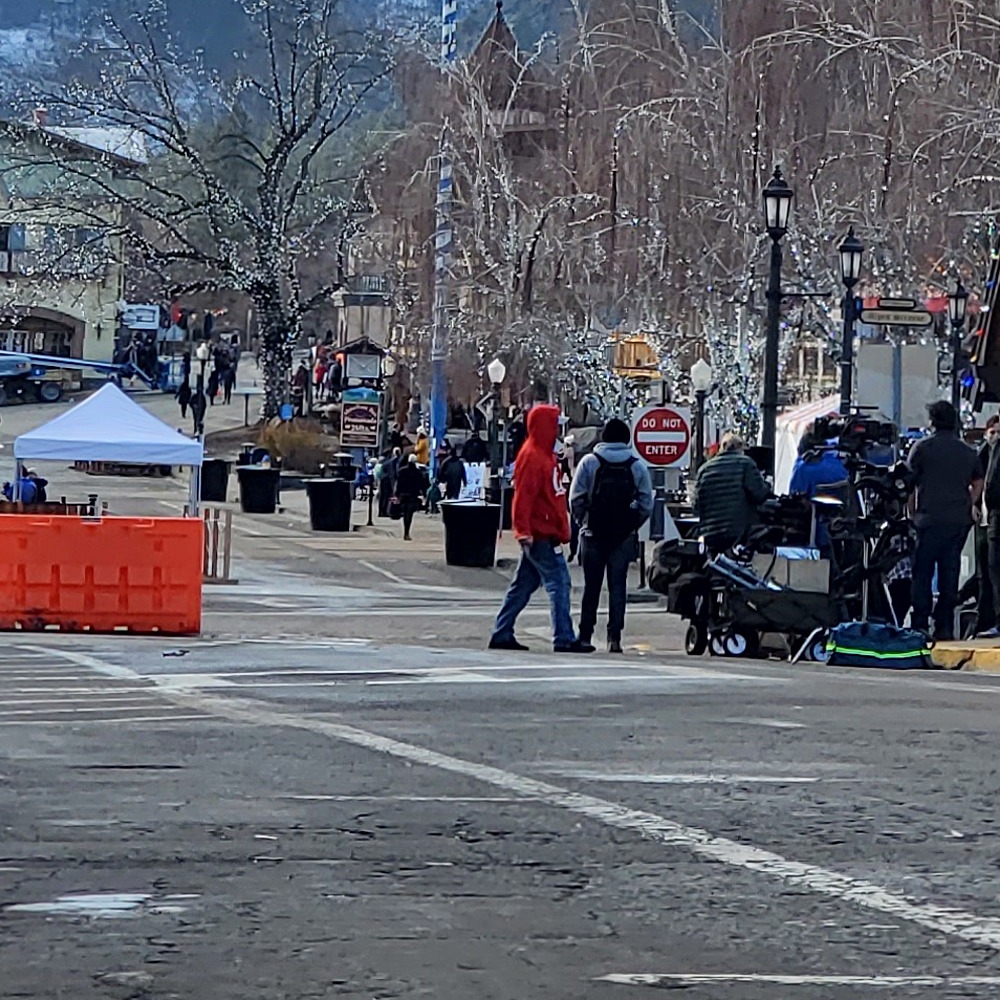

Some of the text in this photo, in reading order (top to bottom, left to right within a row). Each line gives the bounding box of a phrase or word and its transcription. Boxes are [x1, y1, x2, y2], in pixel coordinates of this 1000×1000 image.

[642, 418, 681, 428] DO NOT
[645, 445, 677, 455] ENTER
